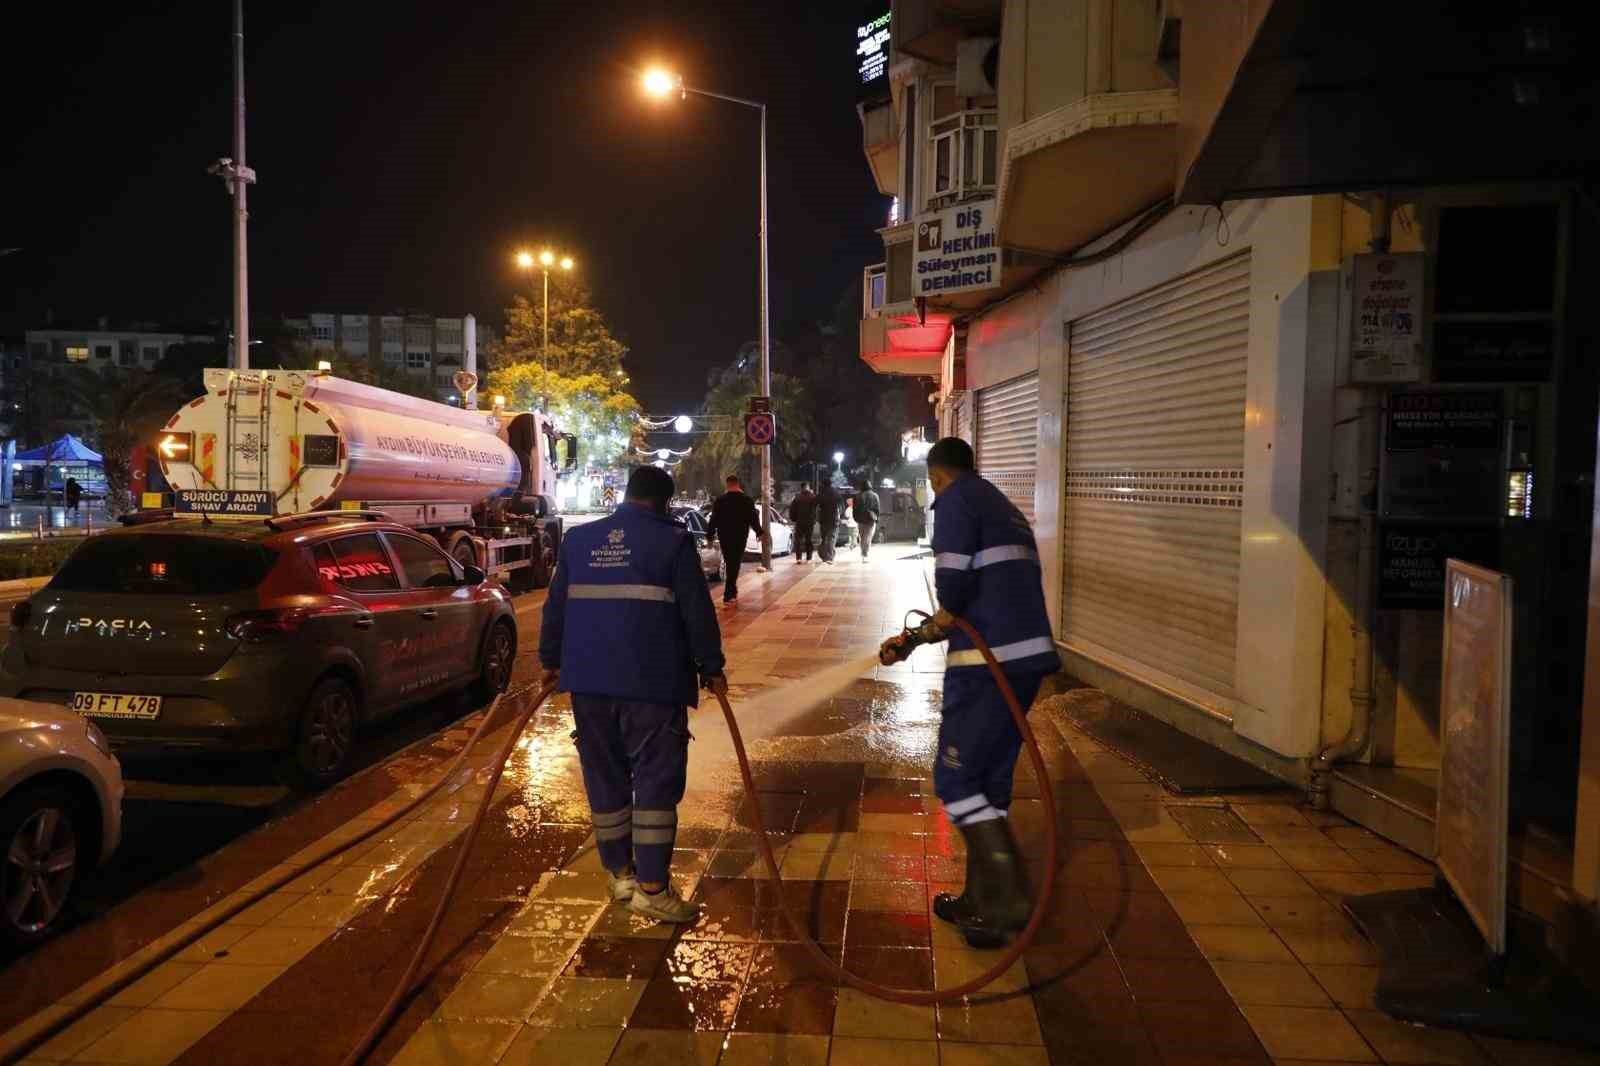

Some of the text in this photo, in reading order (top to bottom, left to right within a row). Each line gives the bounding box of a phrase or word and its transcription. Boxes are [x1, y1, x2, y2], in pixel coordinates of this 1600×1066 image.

[957, 207, 982, 229] DİŞ
[917, 253, 997, 274] Süleyman
[921, 266, 992, 291] DEMİRCİ
[376, 436, 406, 453] AYDIN
[404, 435, 468, 462] BÜYÜKŞEHİR
[181, 490, 267, 503] SÜRÜCÜ ADAYI
[190, 502, 257, 512] SINAV ARACI
[79, 617, 153, 630] DACIA
[74, 694, 158, 713] 09 FT 478
